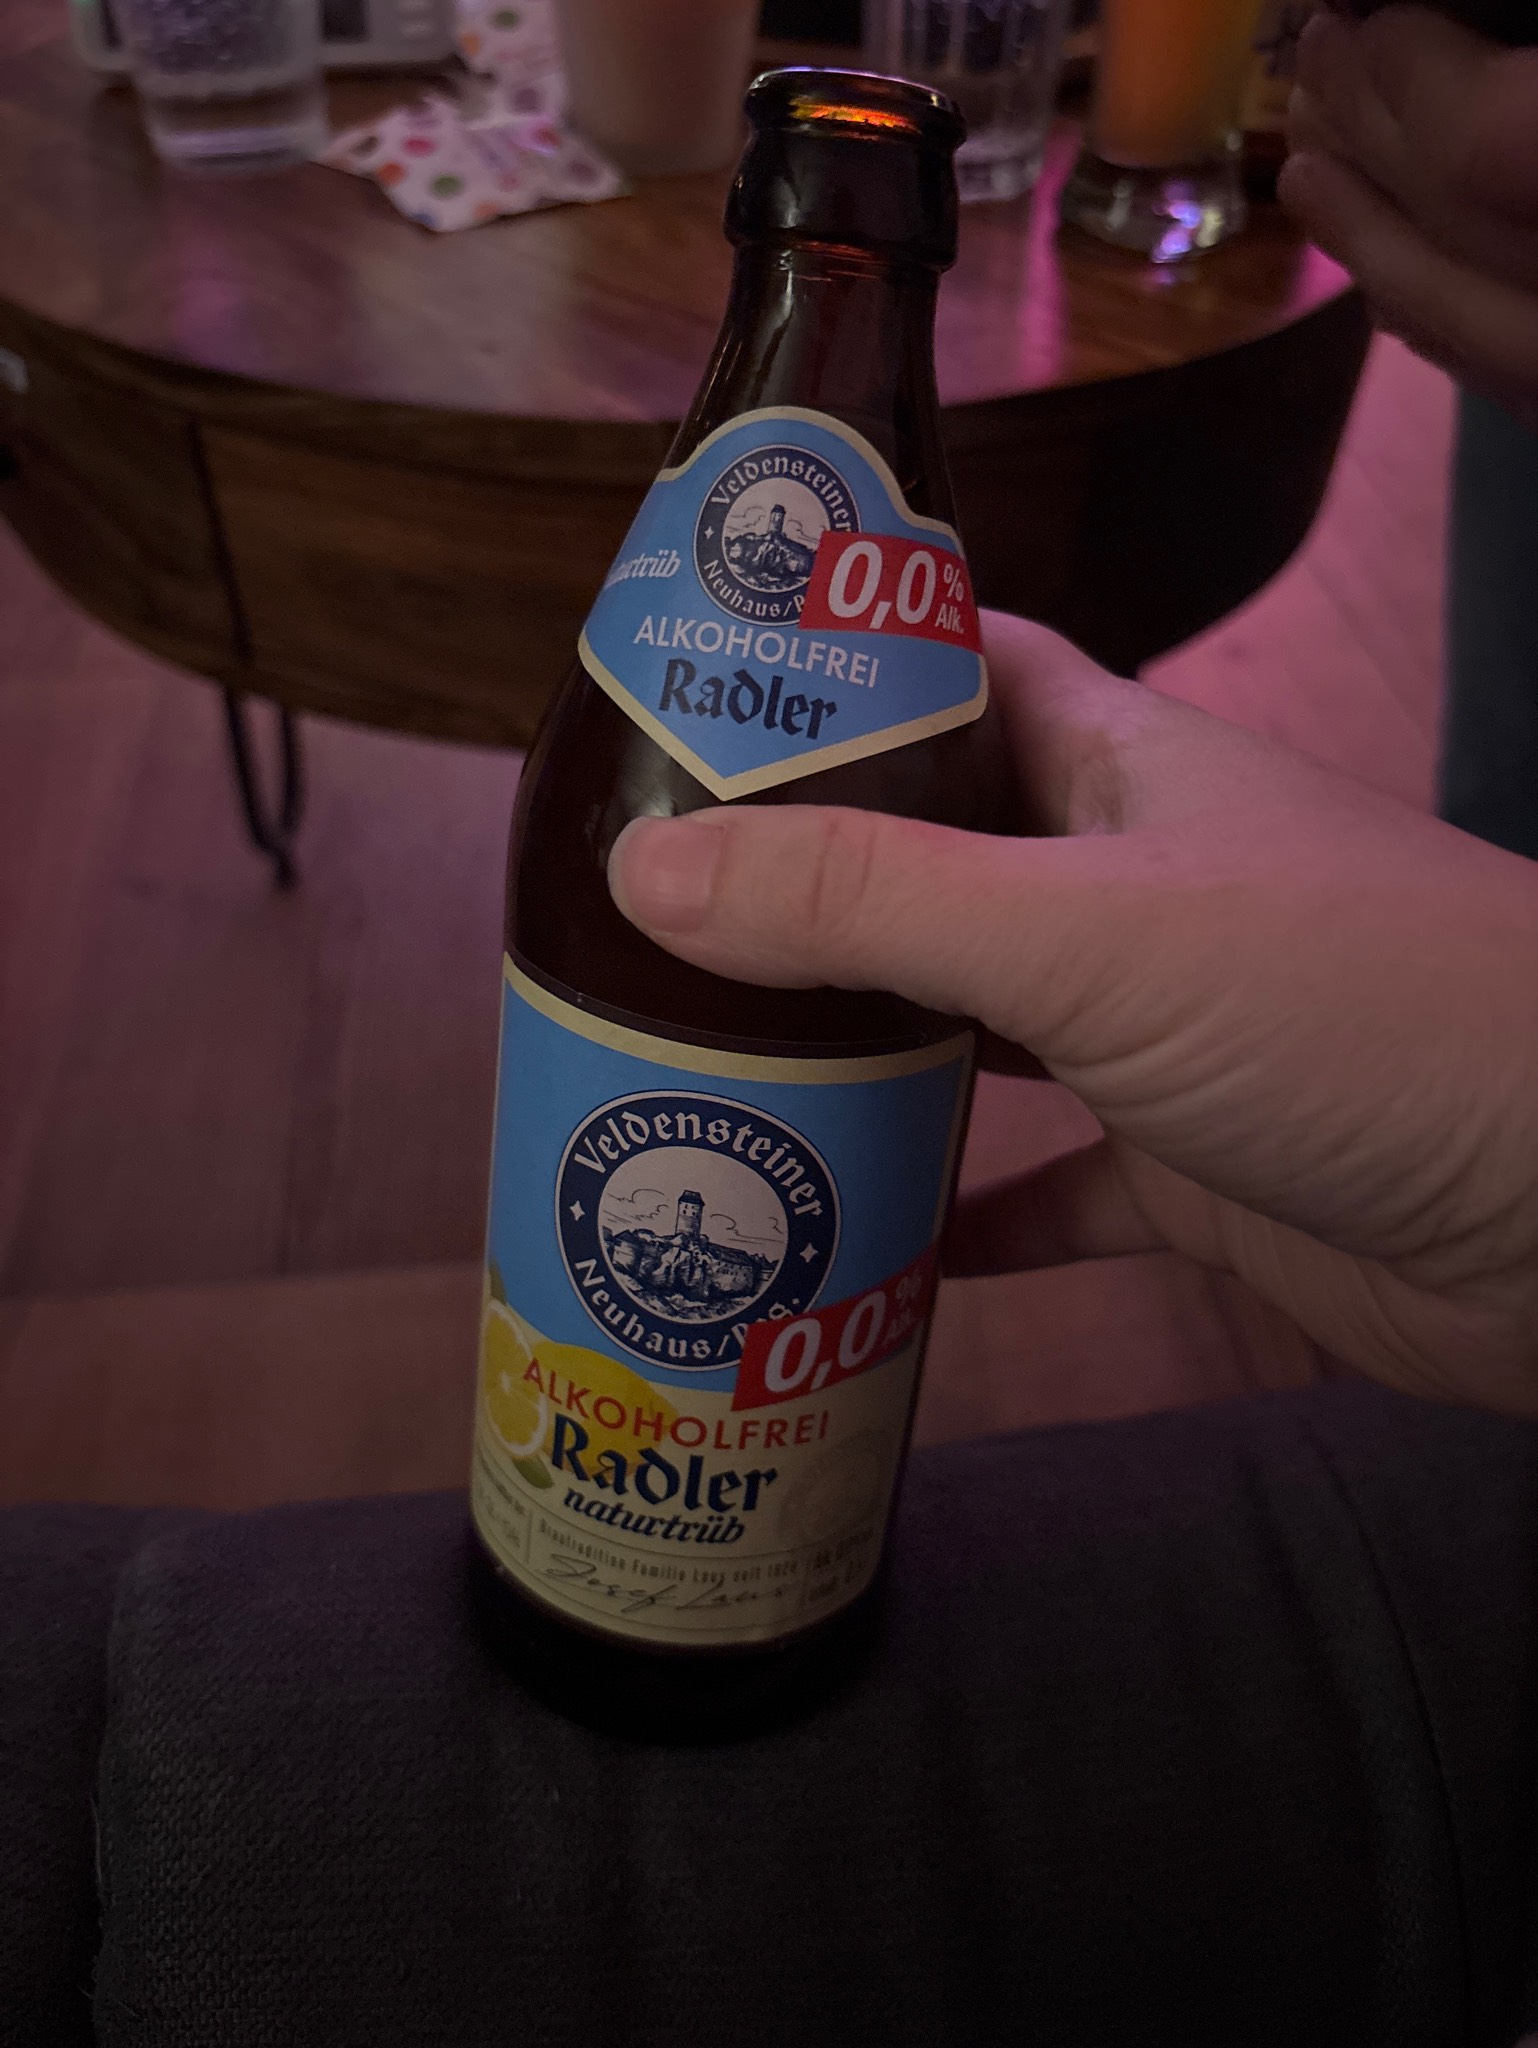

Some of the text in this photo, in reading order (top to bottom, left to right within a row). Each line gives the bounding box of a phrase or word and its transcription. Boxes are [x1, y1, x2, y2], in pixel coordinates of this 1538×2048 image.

[710, 453, 853, 533] Veldensteiner
[827, 540, 937, 630] 0,0
[633, 616, 880, 689] ALKOHOLFREI
[659, 658, 837, 740] Radler
[574, 1110, 824, 1217] Veldensteiner
[764, 1290, 887, 1394] 0,0
[524, 1358, 829, 1450] ALKOHOLFREI
[552, 1412, 777, 1512] Radler
[563, 1486, 746, 1544] naturtrüb
